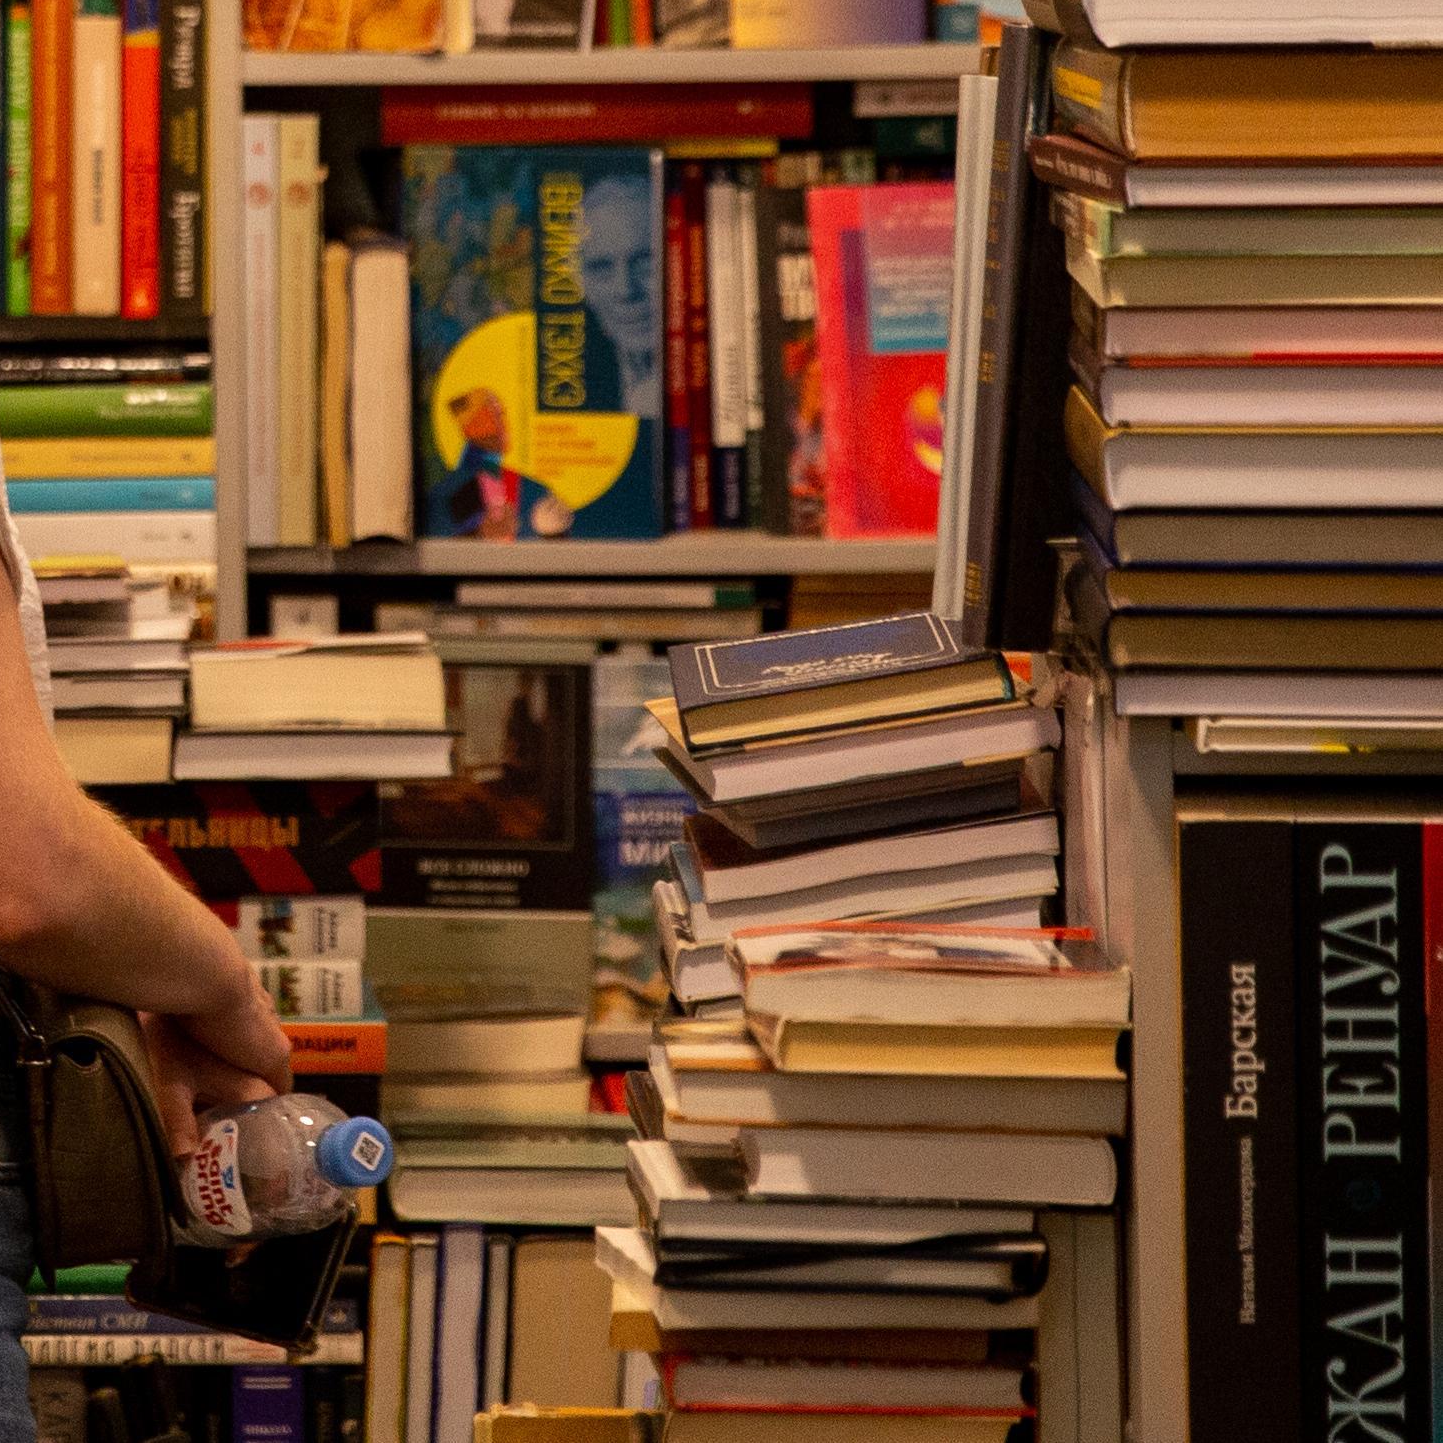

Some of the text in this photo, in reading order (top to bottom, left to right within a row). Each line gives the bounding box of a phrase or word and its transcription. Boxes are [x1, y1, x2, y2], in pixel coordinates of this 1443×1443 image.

[1223, 963, 1265, 1119] Барская
[1317, 843, 1403, 1165] РЕНУАР
[1324, 1233, 1408, 1443] ЖАН
